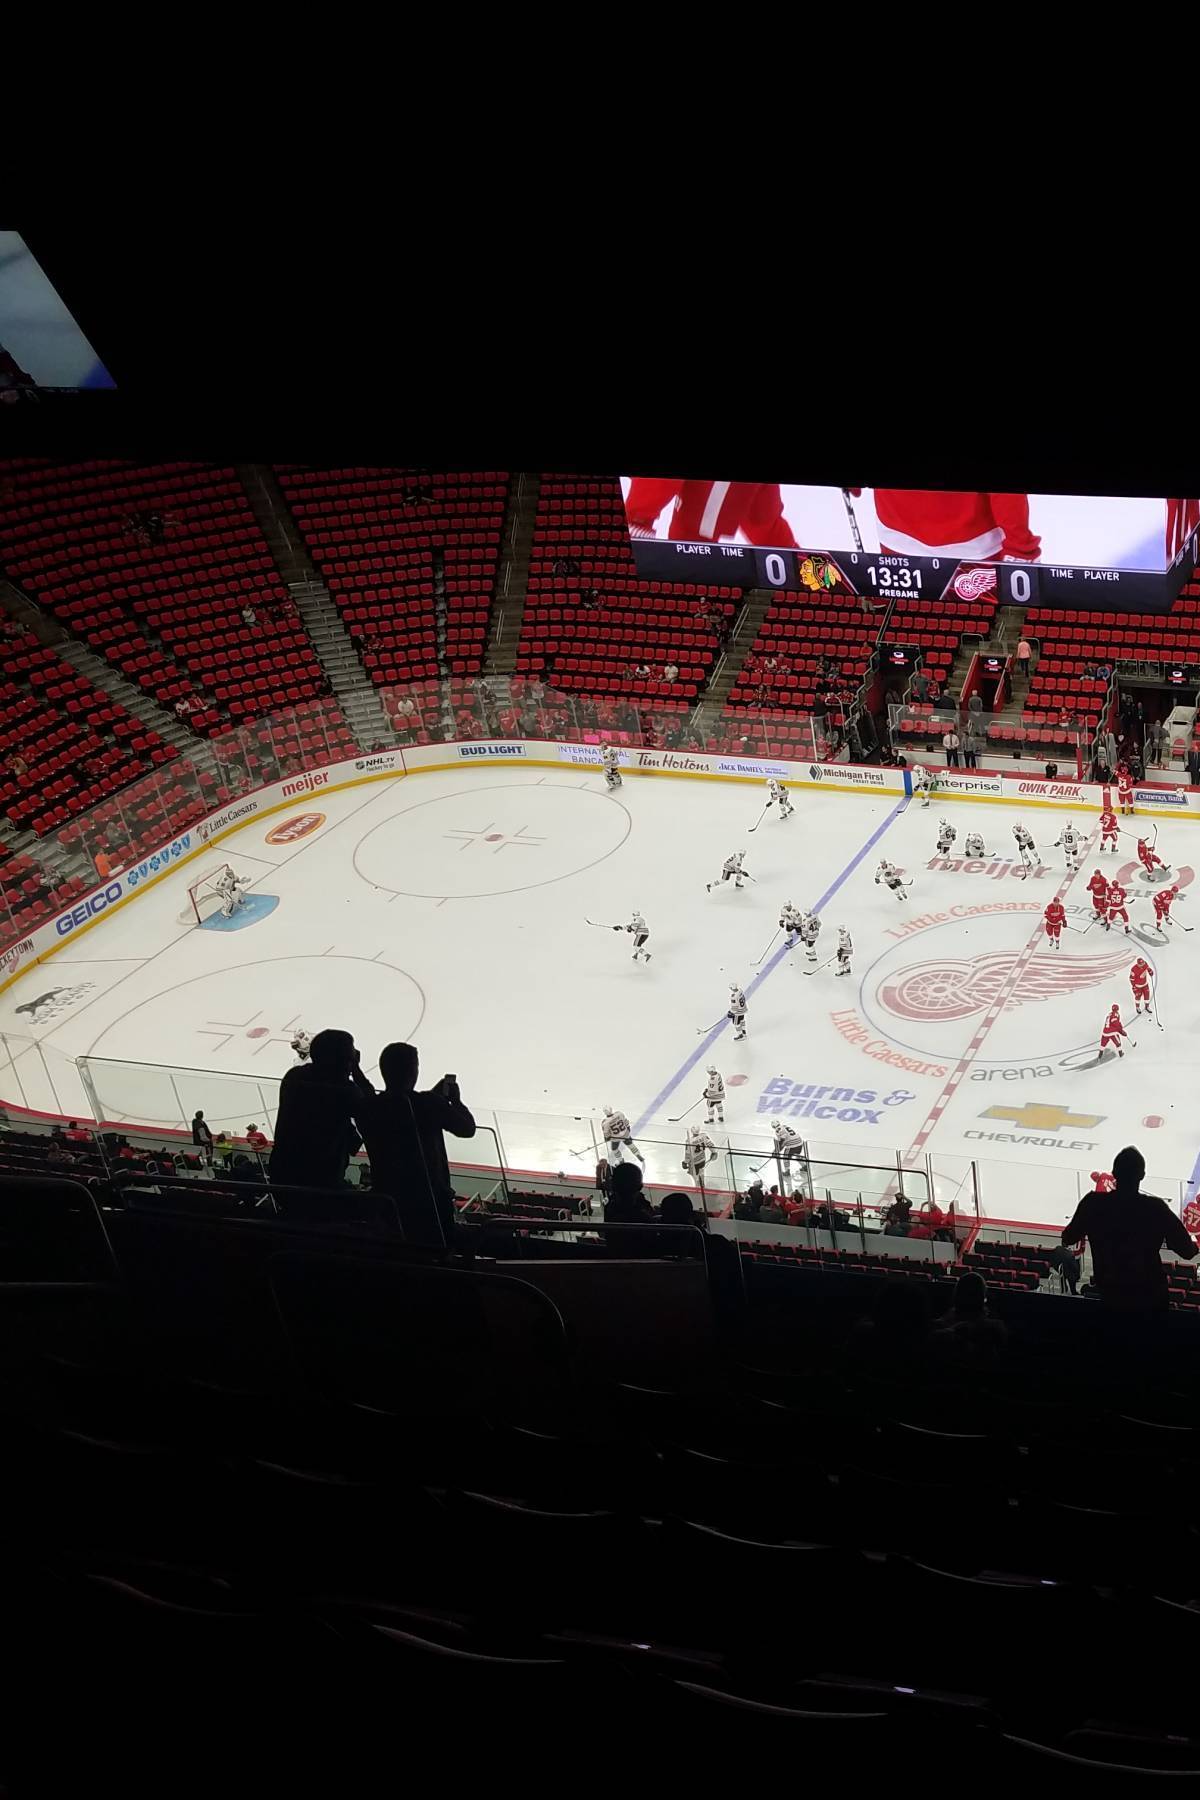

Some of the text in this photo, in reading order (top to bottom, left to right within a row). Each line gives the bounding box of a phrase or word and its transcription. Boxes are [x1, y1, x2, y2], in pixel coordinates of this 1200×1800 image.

[676, 544, 744, 557] PLAYER TIME
[851, 553, 859, 564] 0
[765, 553, 787, 586] 0
[878, 556, 909, 567] SHOTS
[932, 558, 940, 570] 0
[867, 566, 923, 589] 13:31
[1050, 568, 1120, 582] TIME PLAYER
[879, 588, 919, 599] PREGAME
[1010, 569, 1031, 602] 0
[461, 745, 522, 757] BUD LIGHT
[636, 752, 710, 772] Tim Hortons
[281, 771, 330, 798] meijer
[823, 768, 884, 781] Michigan First
[934, 779, 1001, 792] nterprise
[1018, 782, 1082, 797] QWIK PARK
[209, 801, 258, 833] Little Caesars
[271, 814, 321, 843] Tyson
[1063, 834, 1073, 844] 19
[926, 857, 1054, 880] meijer
[55, 882, 123, 936] GEICO
[882, 899, 1042, 940] Little Caesars
[829, 1008, 950, 1079] Little Caesars
[970, 1064, 1055, 1082] arena
[762, 1077, 916, 1107] Burns &
[756, 1095, 886, 1124] Wilcox
[609, 1120, 626, 1136] 52
[963, 1130, 1099, 1151] CHEVROLET
